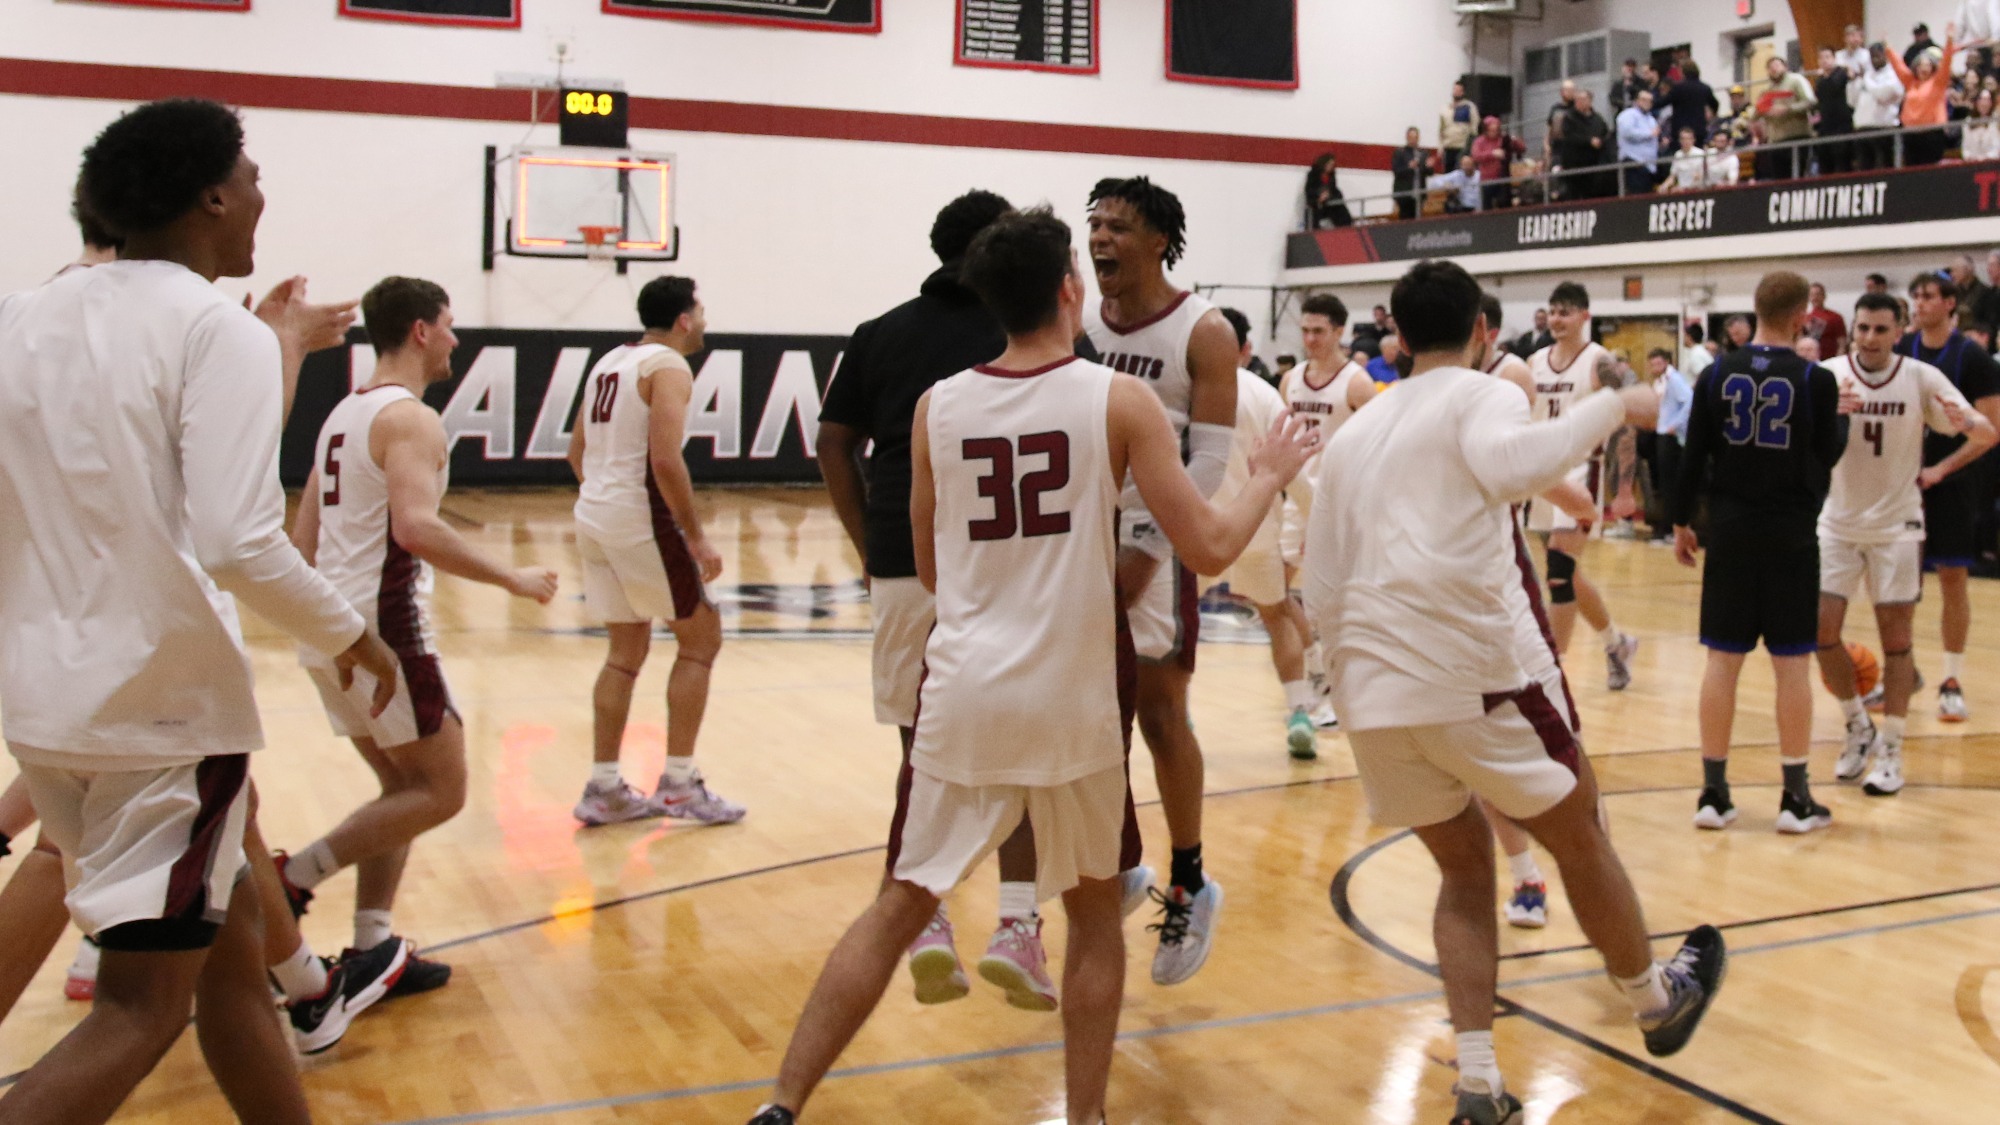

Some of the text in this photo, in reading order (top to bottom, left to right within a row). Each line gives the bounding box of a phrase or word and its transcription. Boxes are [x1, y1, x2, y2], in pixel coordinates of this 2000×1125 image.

[1517, 209, 1597, 244] LEADERSHIP
[1648, 198, 1715, 233] RESPECT
[1768, 181, 1888, 225] COMMITMENT
[591, 372, 619, 423] 10
[1721, 372, 1795, 450] 32
[1863, 421, 1883, 457] 4
[323, 433, 345, 507] 5
[962, 430, 1071, 541] 32
